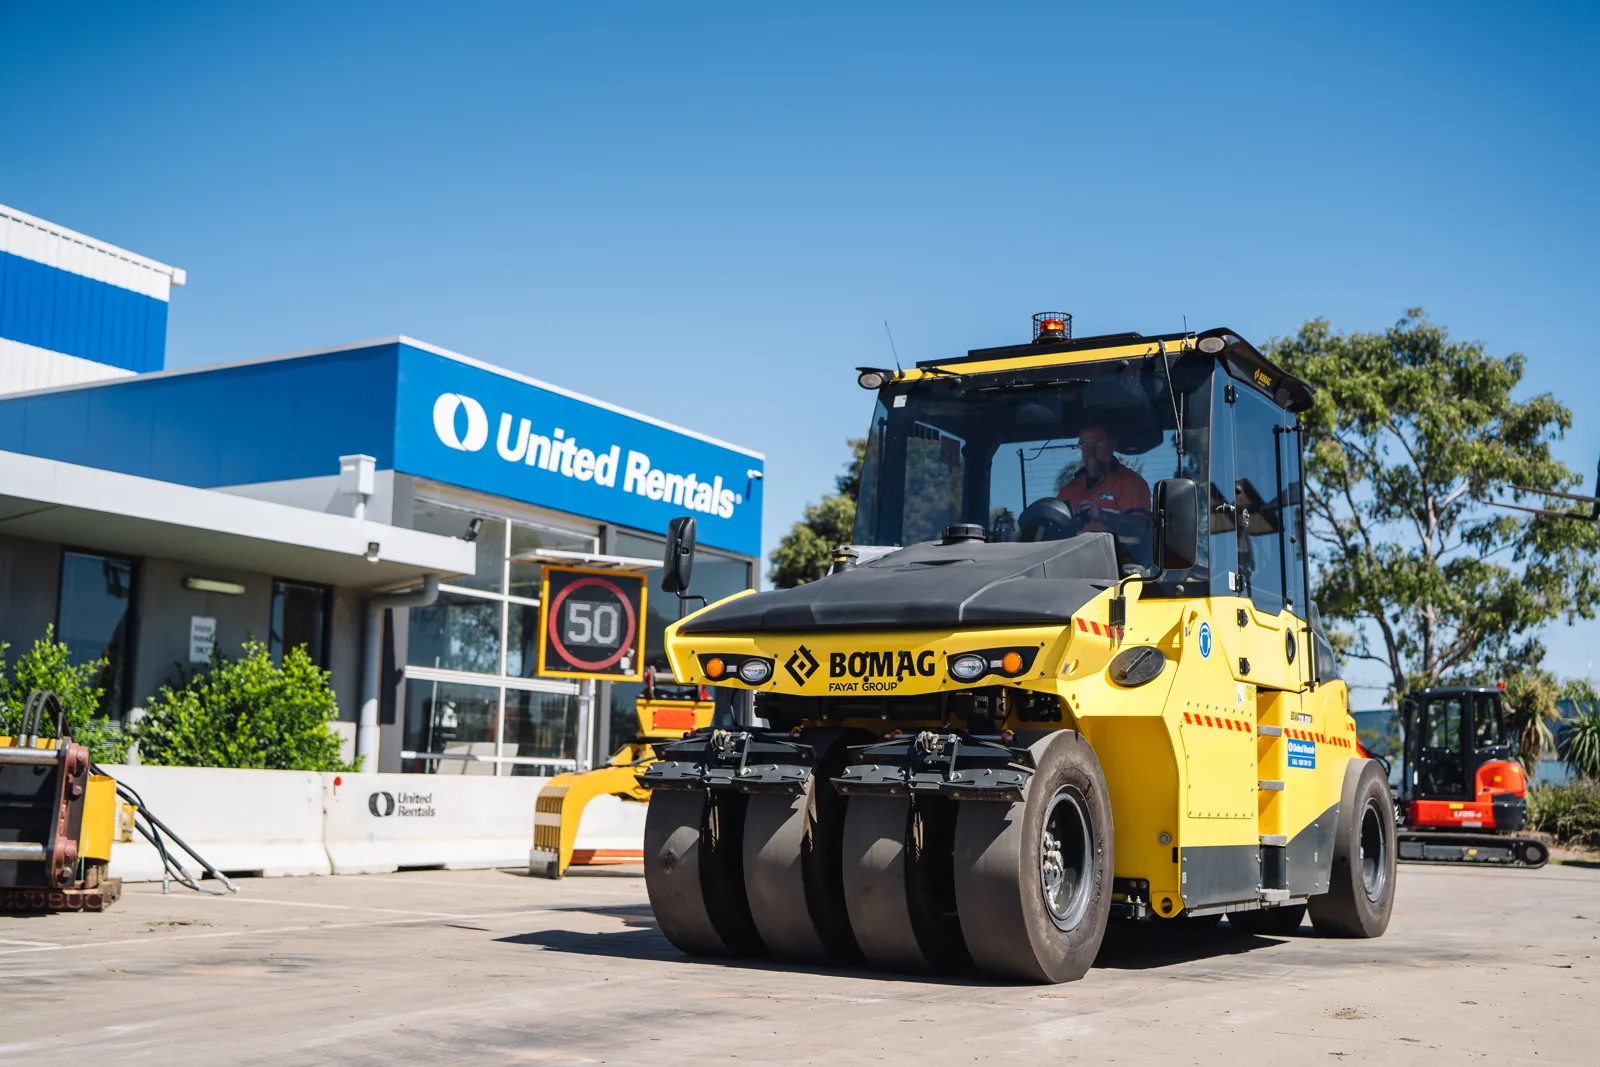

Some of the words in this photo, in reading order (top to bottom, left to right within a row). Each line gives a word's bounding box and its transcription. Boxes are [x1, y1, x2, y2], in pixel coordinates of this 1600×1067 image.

[496, 412, 621, 488] United
[623, 449, 736, 519] Rentals
[568, 603, 618, 645] 50
[829, 650, 936, 678] BOMAG
[828, 682, 859, 692] FAYAT
[862, 682, 898, 692] GROUP
[398, 792, 433, 804] United
[398, 806, 436, 817] Rentals
